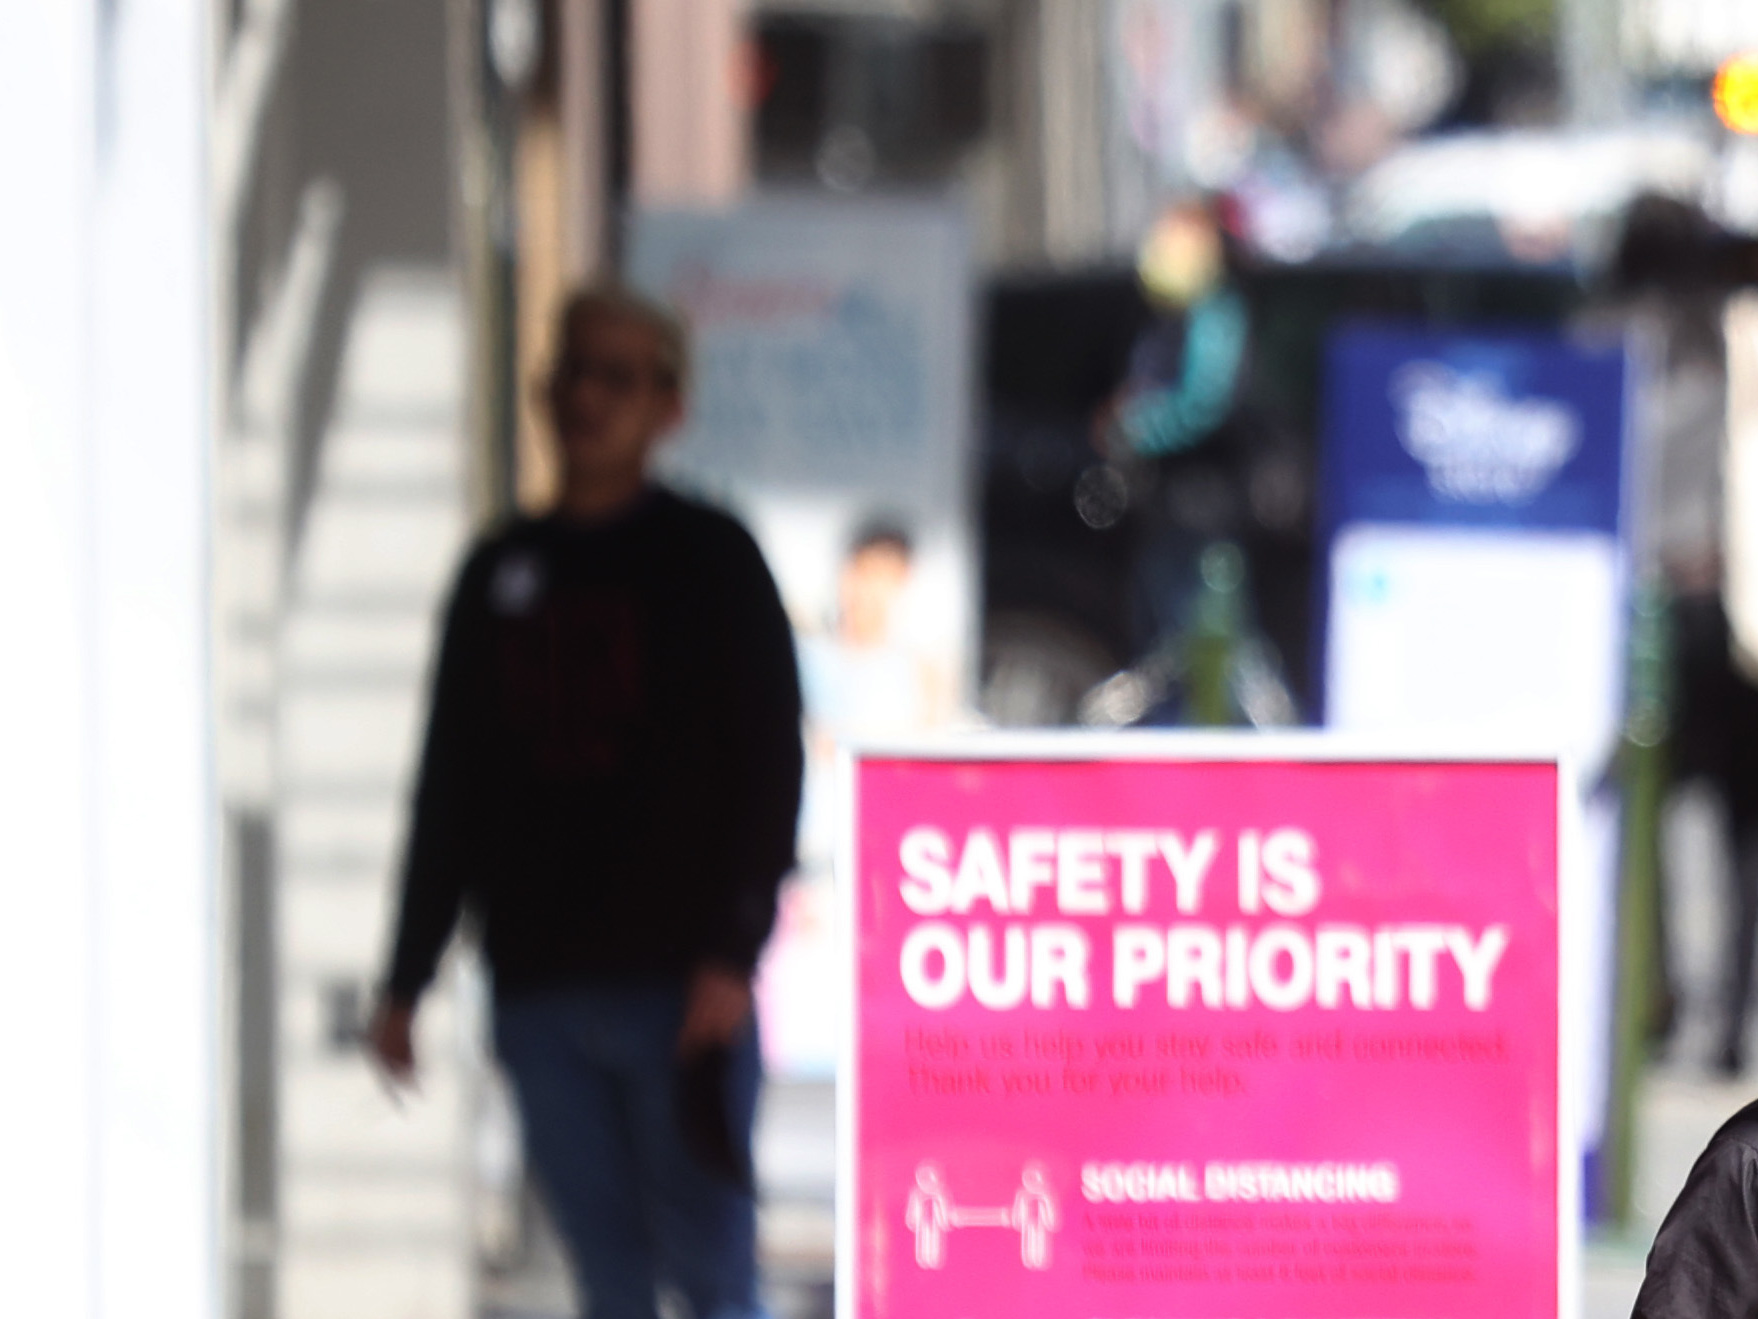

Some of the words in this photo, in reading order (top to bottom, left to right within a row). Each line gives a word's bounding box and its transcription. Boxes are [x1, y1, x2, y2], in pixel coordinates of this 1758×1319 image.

[900, 826, 1218, 915] SAFETY
[1238, 826, 1322, 915] IS
[900, 922, 1091, 1010] OUR
[1113, 922, 1509, 1010] PRIORITY
[1081, 1162, 1200, 1202] SOCIAL
[1204, 1162, 1398, 1202] DISTANCING
